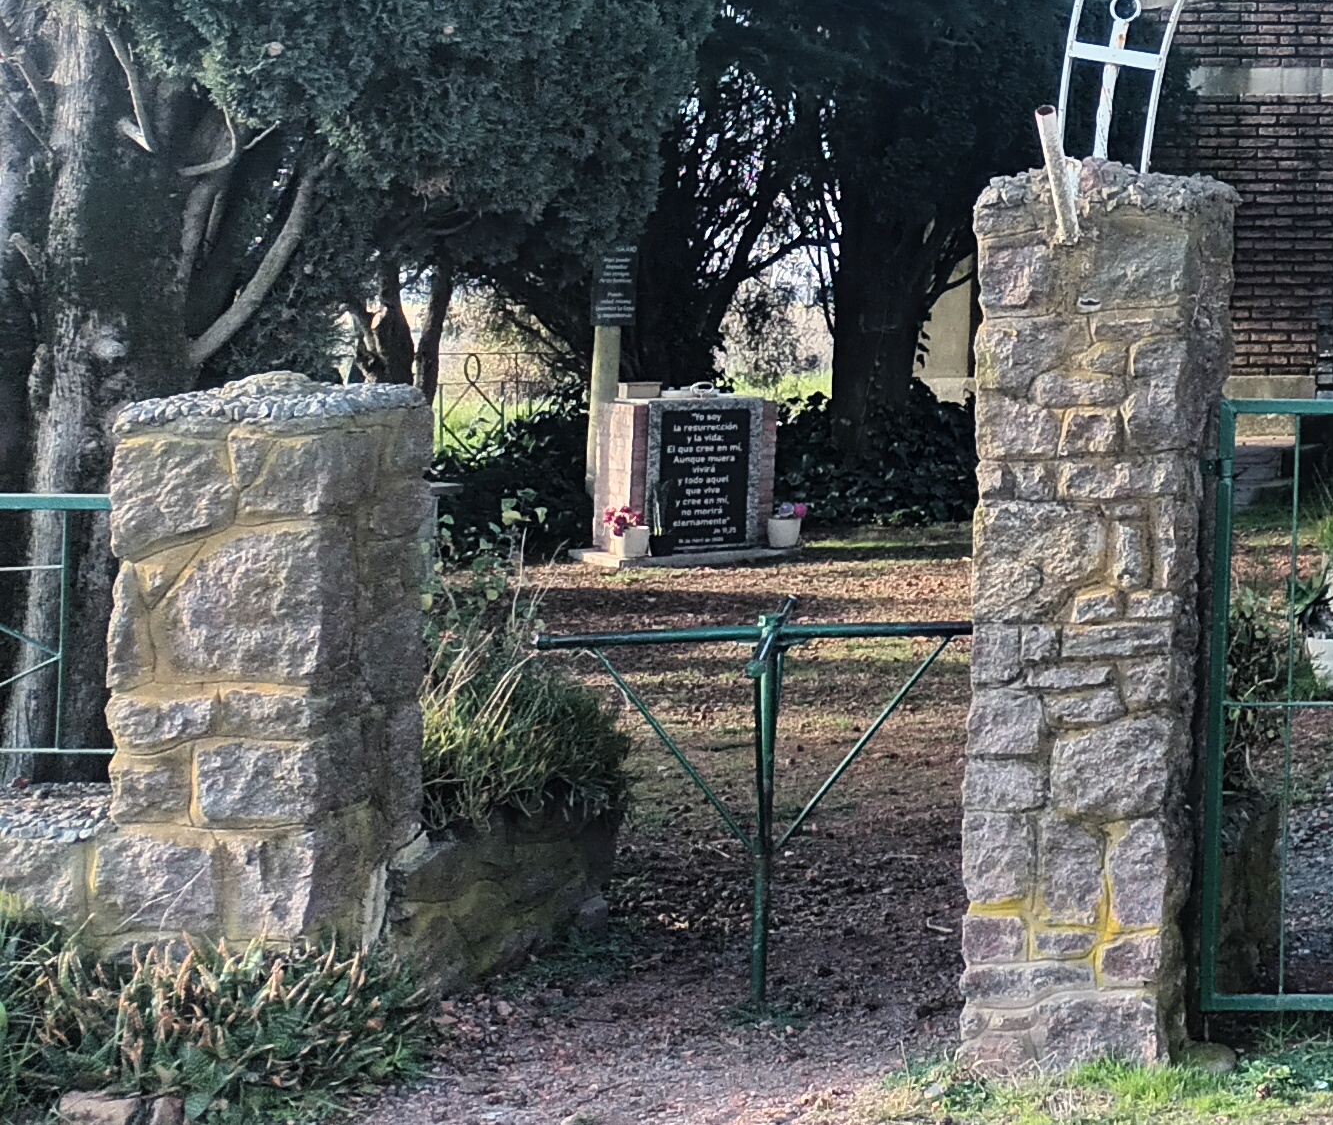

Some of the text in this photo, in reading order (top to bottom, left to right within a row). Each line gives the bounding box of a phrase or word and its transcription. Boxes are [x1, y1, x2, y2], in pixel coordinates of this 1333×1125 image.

[706, 413, 722, 422] soy
[673, 421, 738, 432] la resurrección
[686, 435, 692, 444] y
[693, 434, 702, 442] la
[677, 446, 694, 454] que
[695, 445, 715, 453] cree
[673, 455, 736, 464] Aunque muera
[692, 464, 716, 473] vivirá
[684, 476, 704, 485] todo
[705, 475, 729, 485] aquel
[685, 486, 721, 496] que vive
[682, 498, 701, 506] cree
[703, 497, 715, 505] en
[693, 505, 723, 515] morirá
